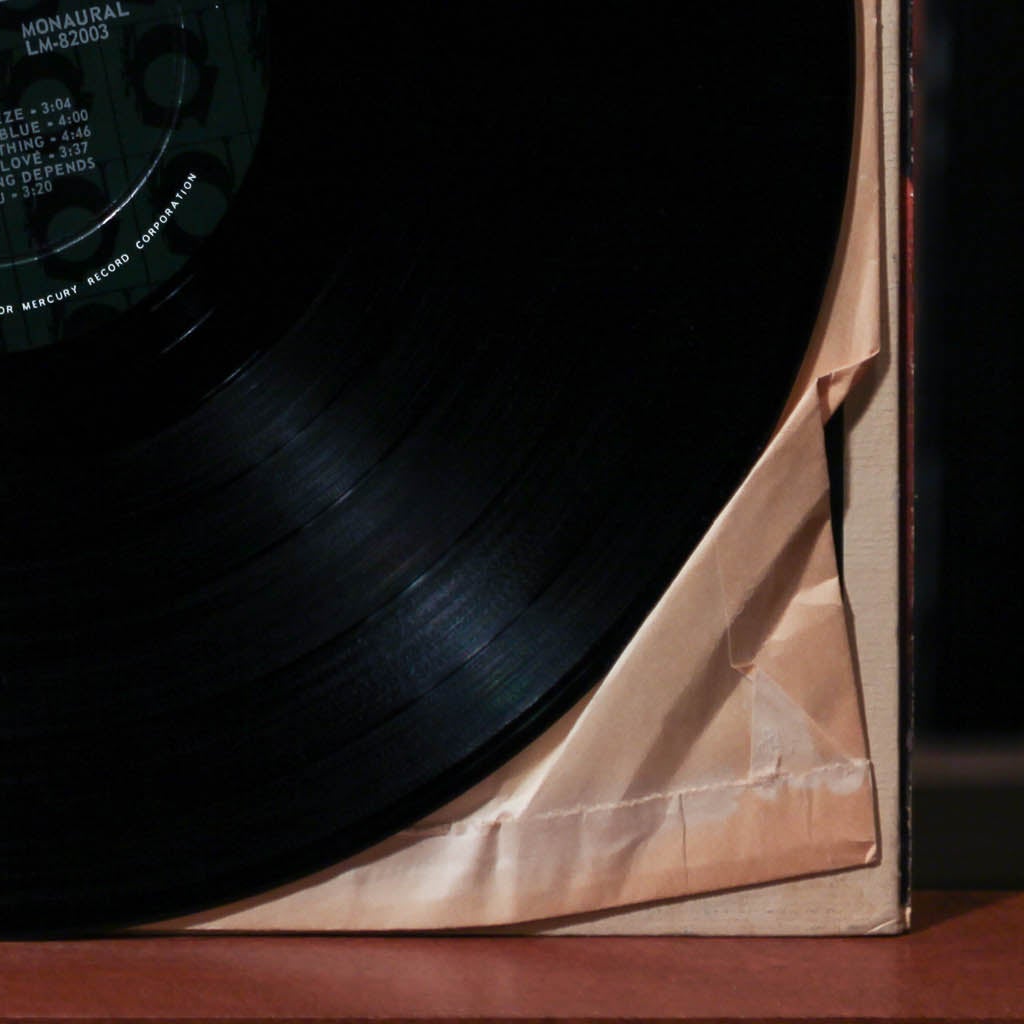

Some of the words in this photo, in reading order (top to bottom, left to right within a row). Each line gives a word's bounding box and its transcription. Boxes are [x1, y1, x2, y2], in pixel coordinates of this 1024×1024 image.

[22, 2, 130, 38] MONAURAL
[26, 24, 109, 56] LM-82003
[41, 98, 71, 114] 3:04
[59, 109, 88, 126] 4:00
[61, 126, 91, 141] 4:46
[0, 151, 41, 173] LOVE
[59, 142, 88, 157] 3:37
[22, 157, 96, 182] DEPENDS
[23, 181, 52, 198] 3:20
[22, 285, 78, 312] MERCURY
[87, 253, 130, 286] RECORD
[135, 173, 198, 250] CORPORATION
